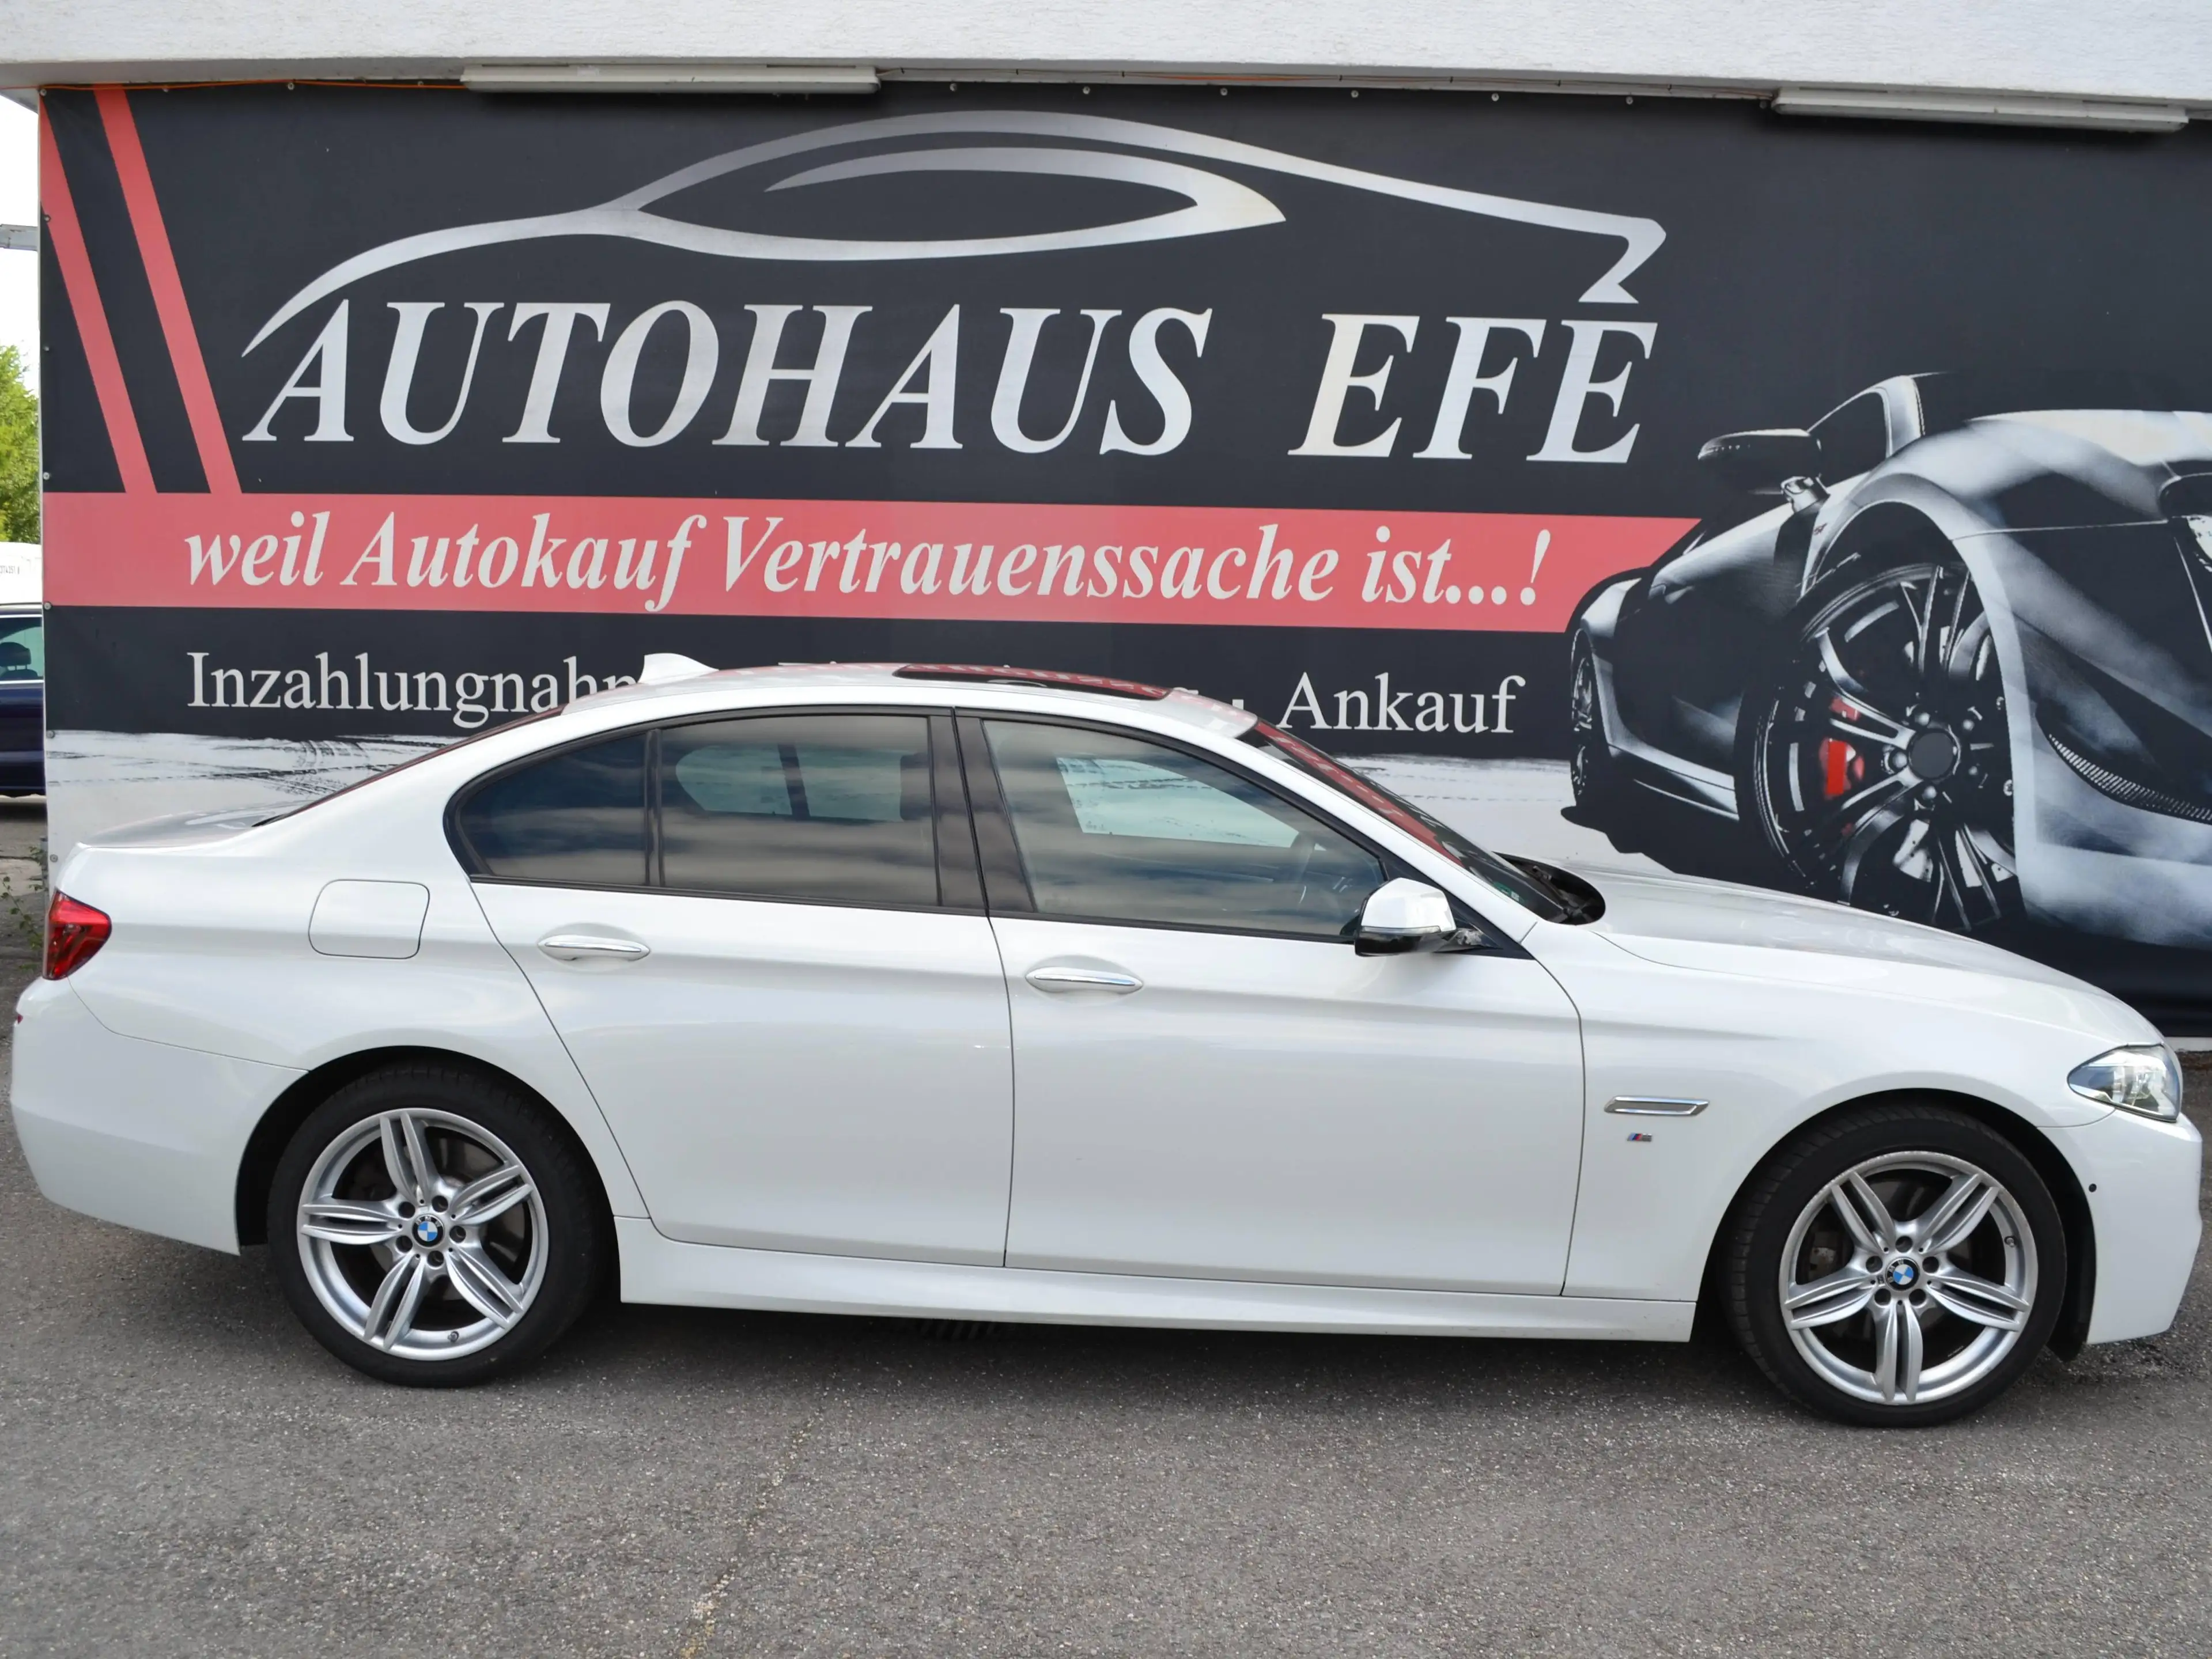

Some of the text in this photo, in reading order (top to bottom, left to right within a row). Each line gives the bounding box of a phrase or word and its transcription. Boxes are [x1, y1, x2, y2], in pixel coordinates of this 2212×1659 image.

[242, 299, 1658, 463] AUTOHAUS EFE
[184, 511, 330, 586] weil
[340, 512, 707, 612] Autokauf
[723, 516, 1338, 601] Vertrauenssache
[187, 652, 1526, 733] Inzahlungnah Ankauf
